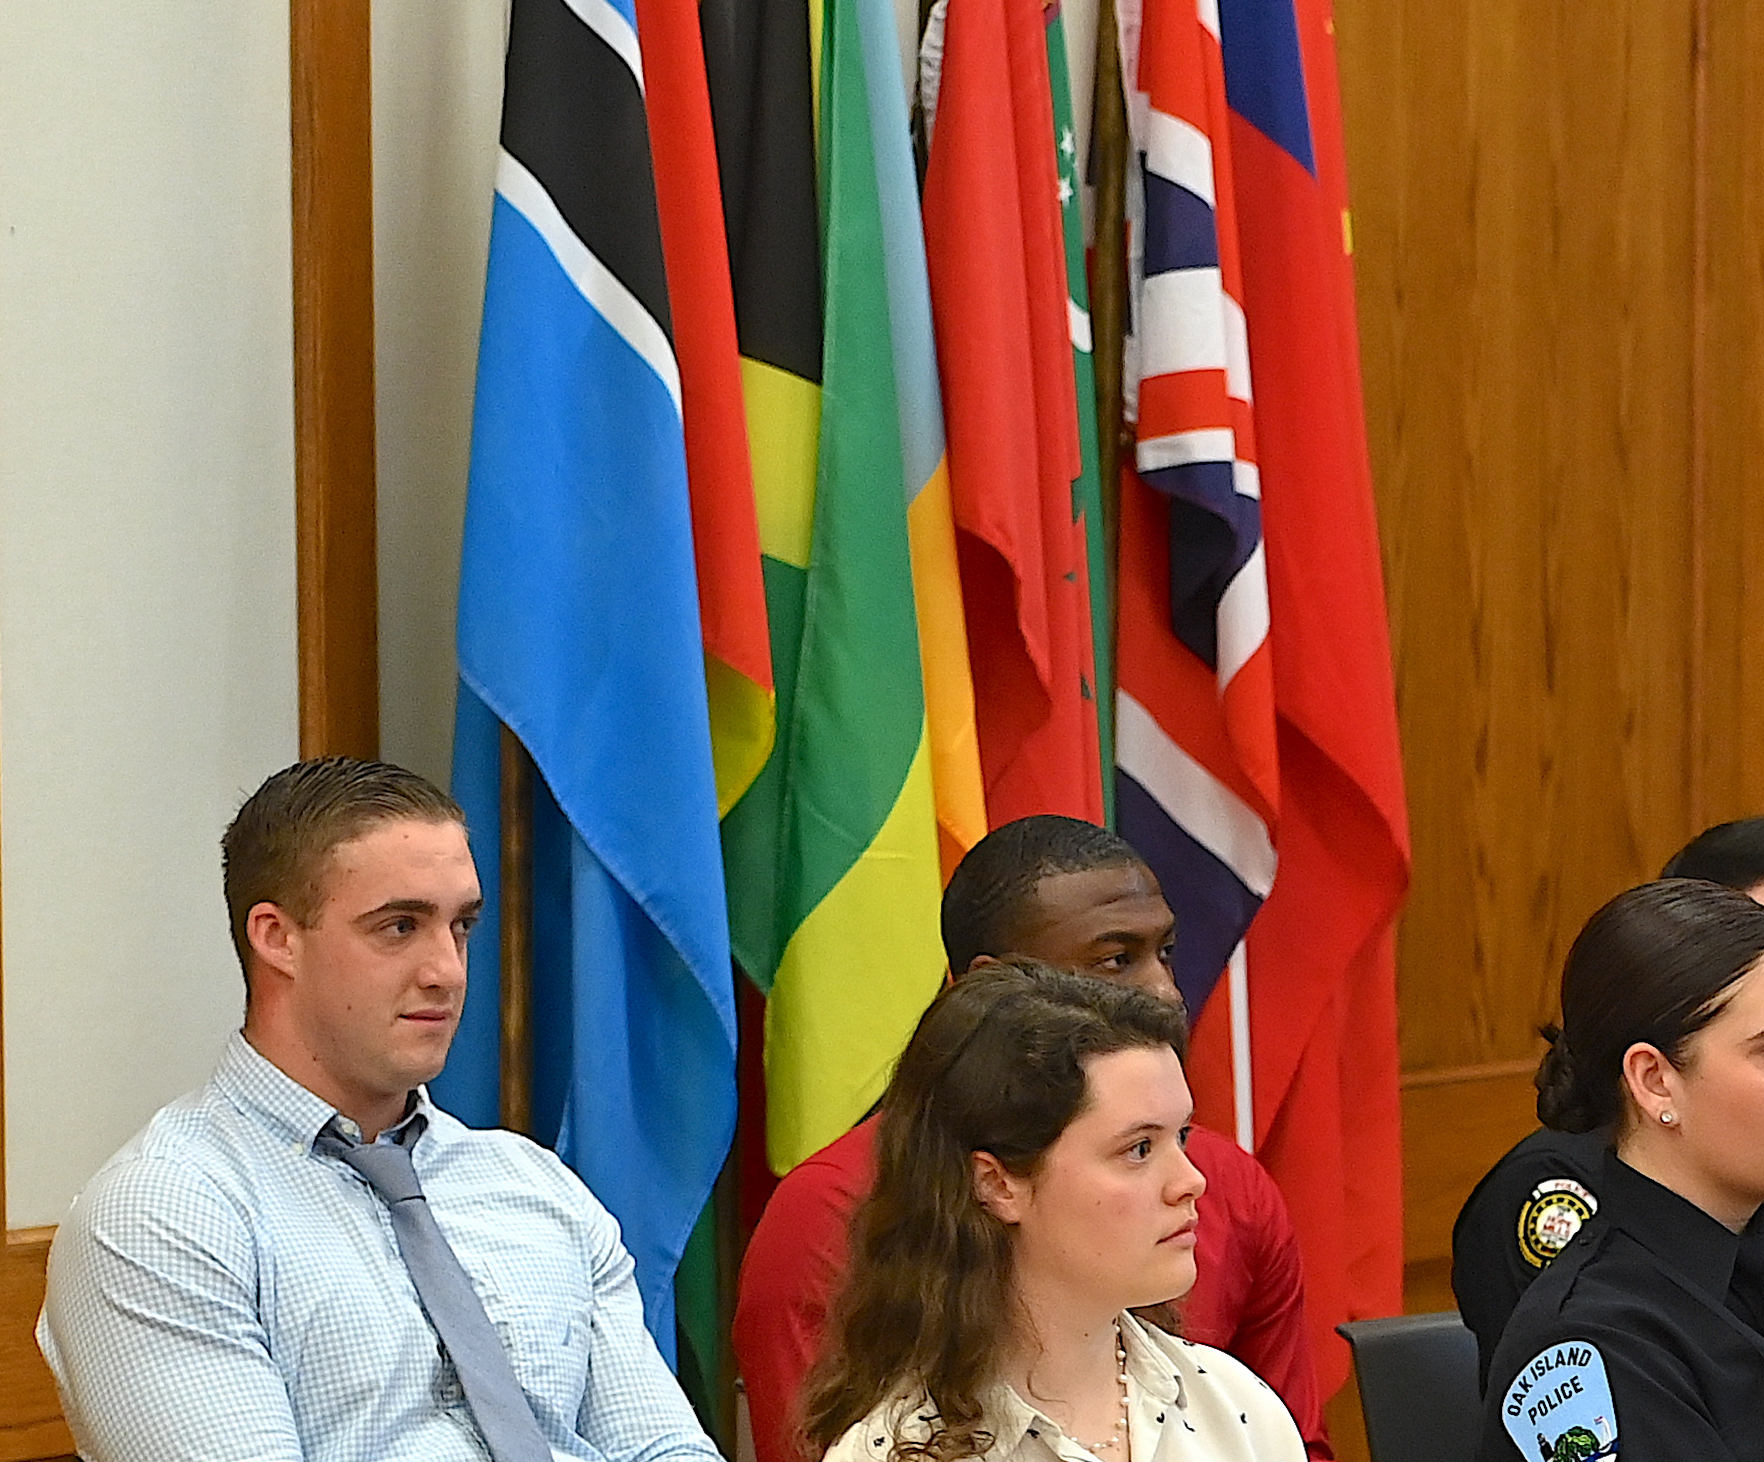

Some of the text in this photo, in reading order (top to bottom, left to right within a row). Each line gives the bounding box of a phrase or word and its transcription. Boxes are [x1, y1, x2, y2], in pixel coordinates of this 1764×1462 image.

[1507, 1347, 1592, 1417] OAK ISLAND
[1527, 1375, 1584, 1426] POLICE
